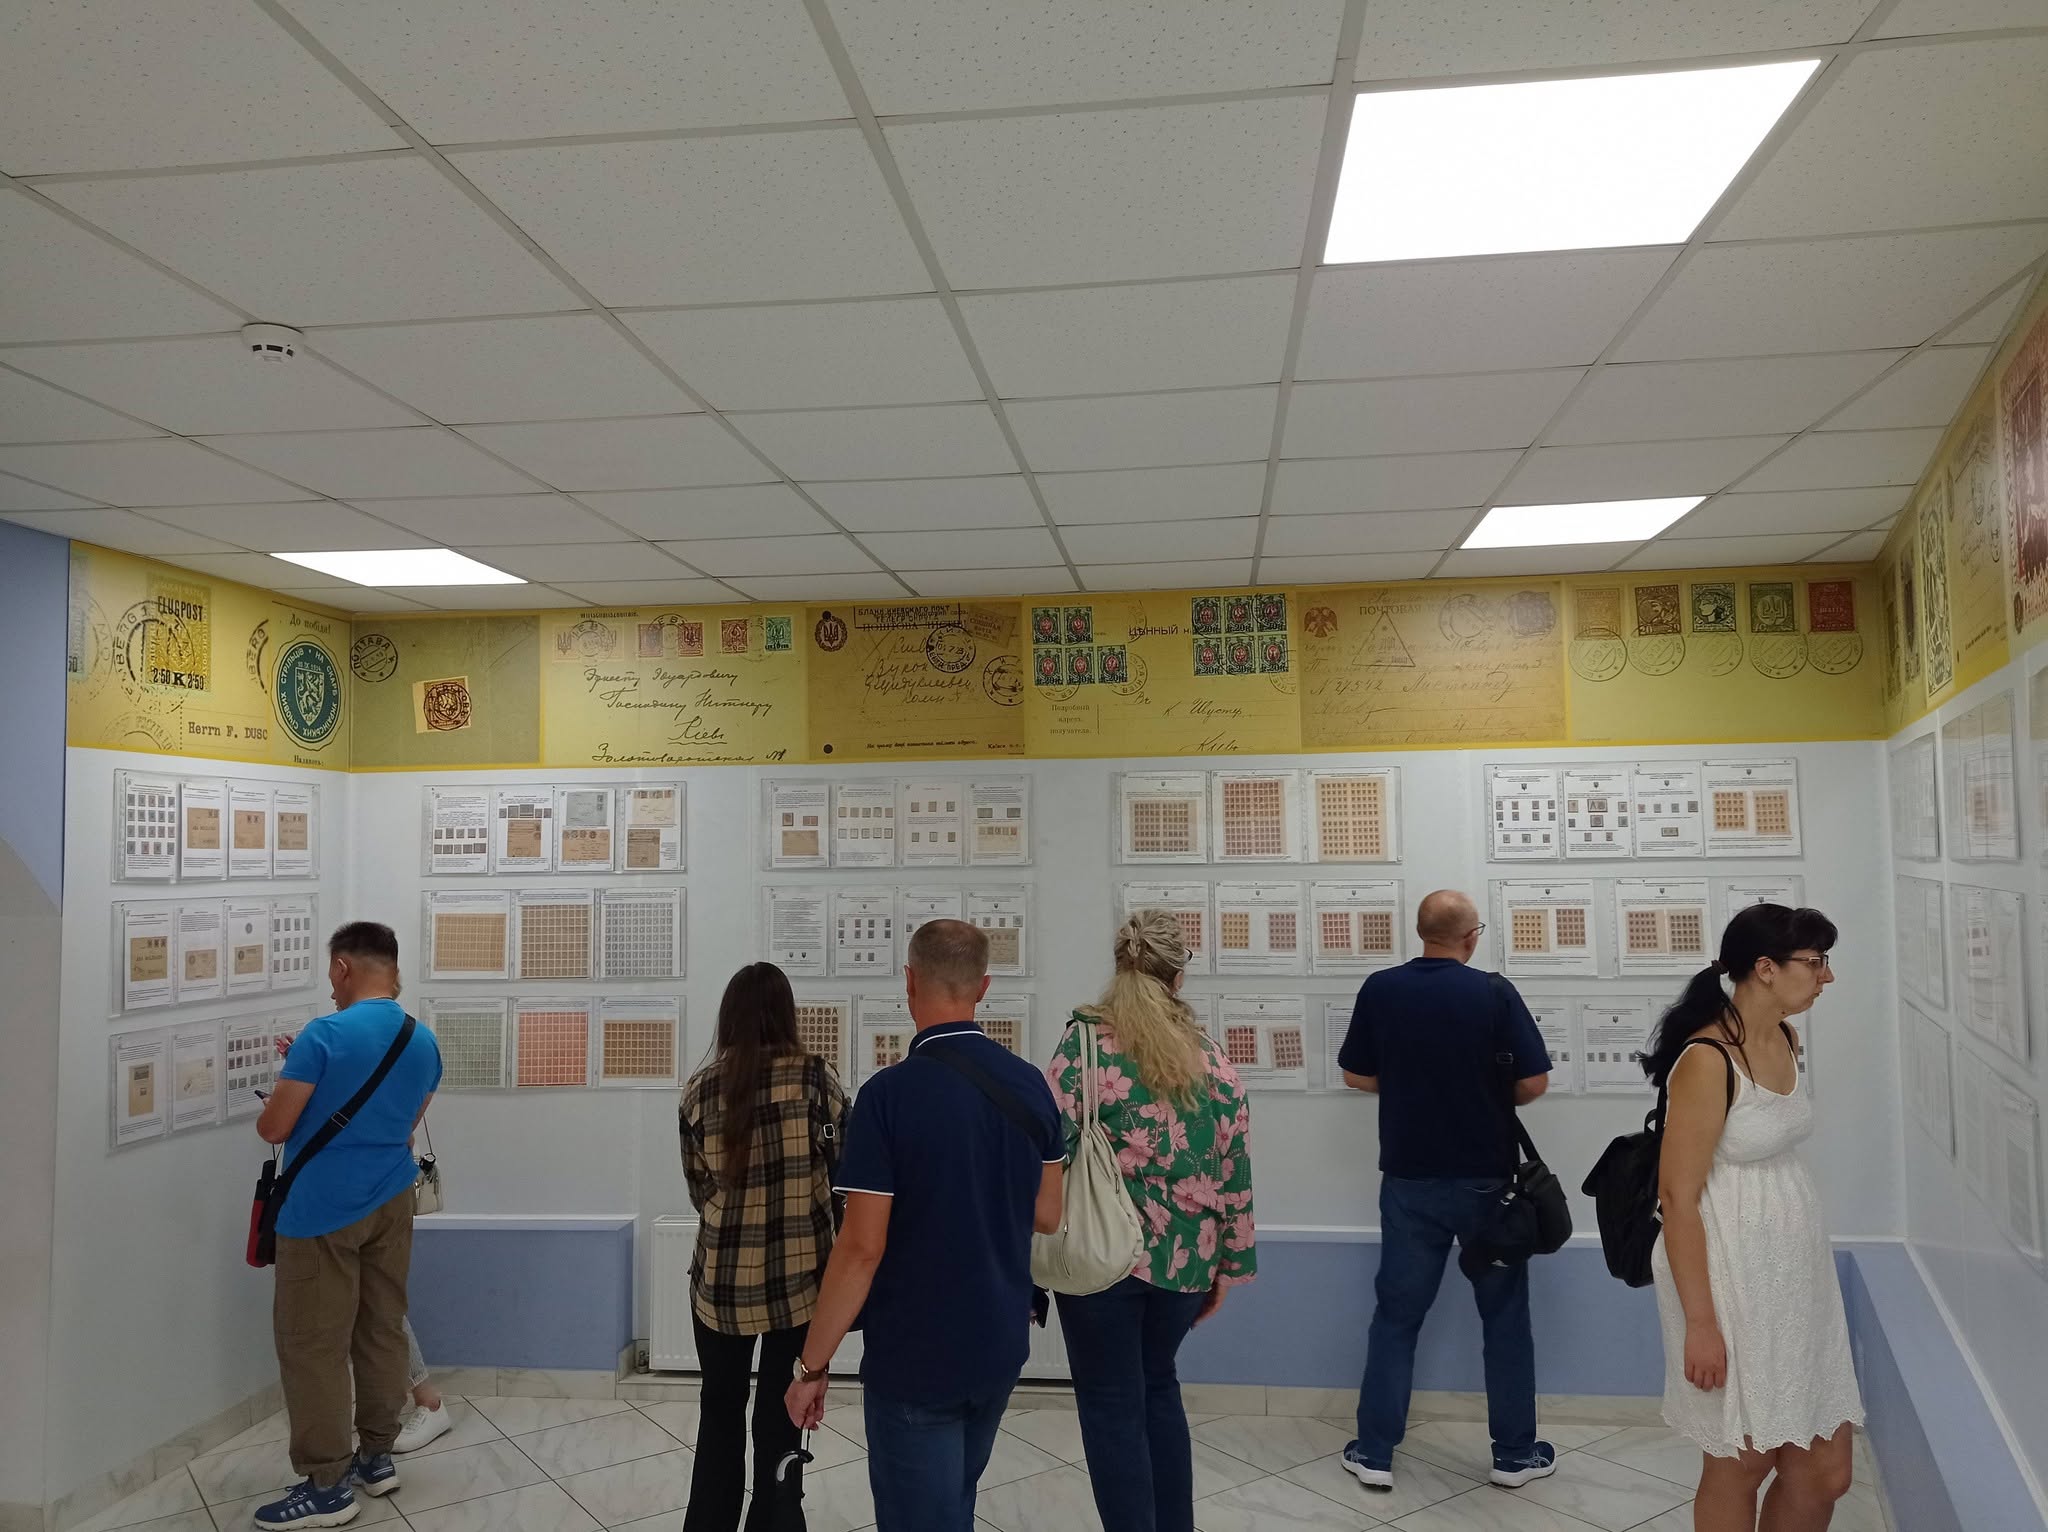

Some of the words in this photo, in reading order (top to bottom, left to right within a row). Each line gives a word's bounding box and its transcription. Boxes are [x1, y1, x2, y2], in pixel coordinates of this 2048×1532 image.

[157, 595, 204, 622] FLUGPOST
[352, 637, 391, 669] ПОЛТАВА
[187, 720, 223, 737] Herrn
[244, 724, 268, 740] DUSC
